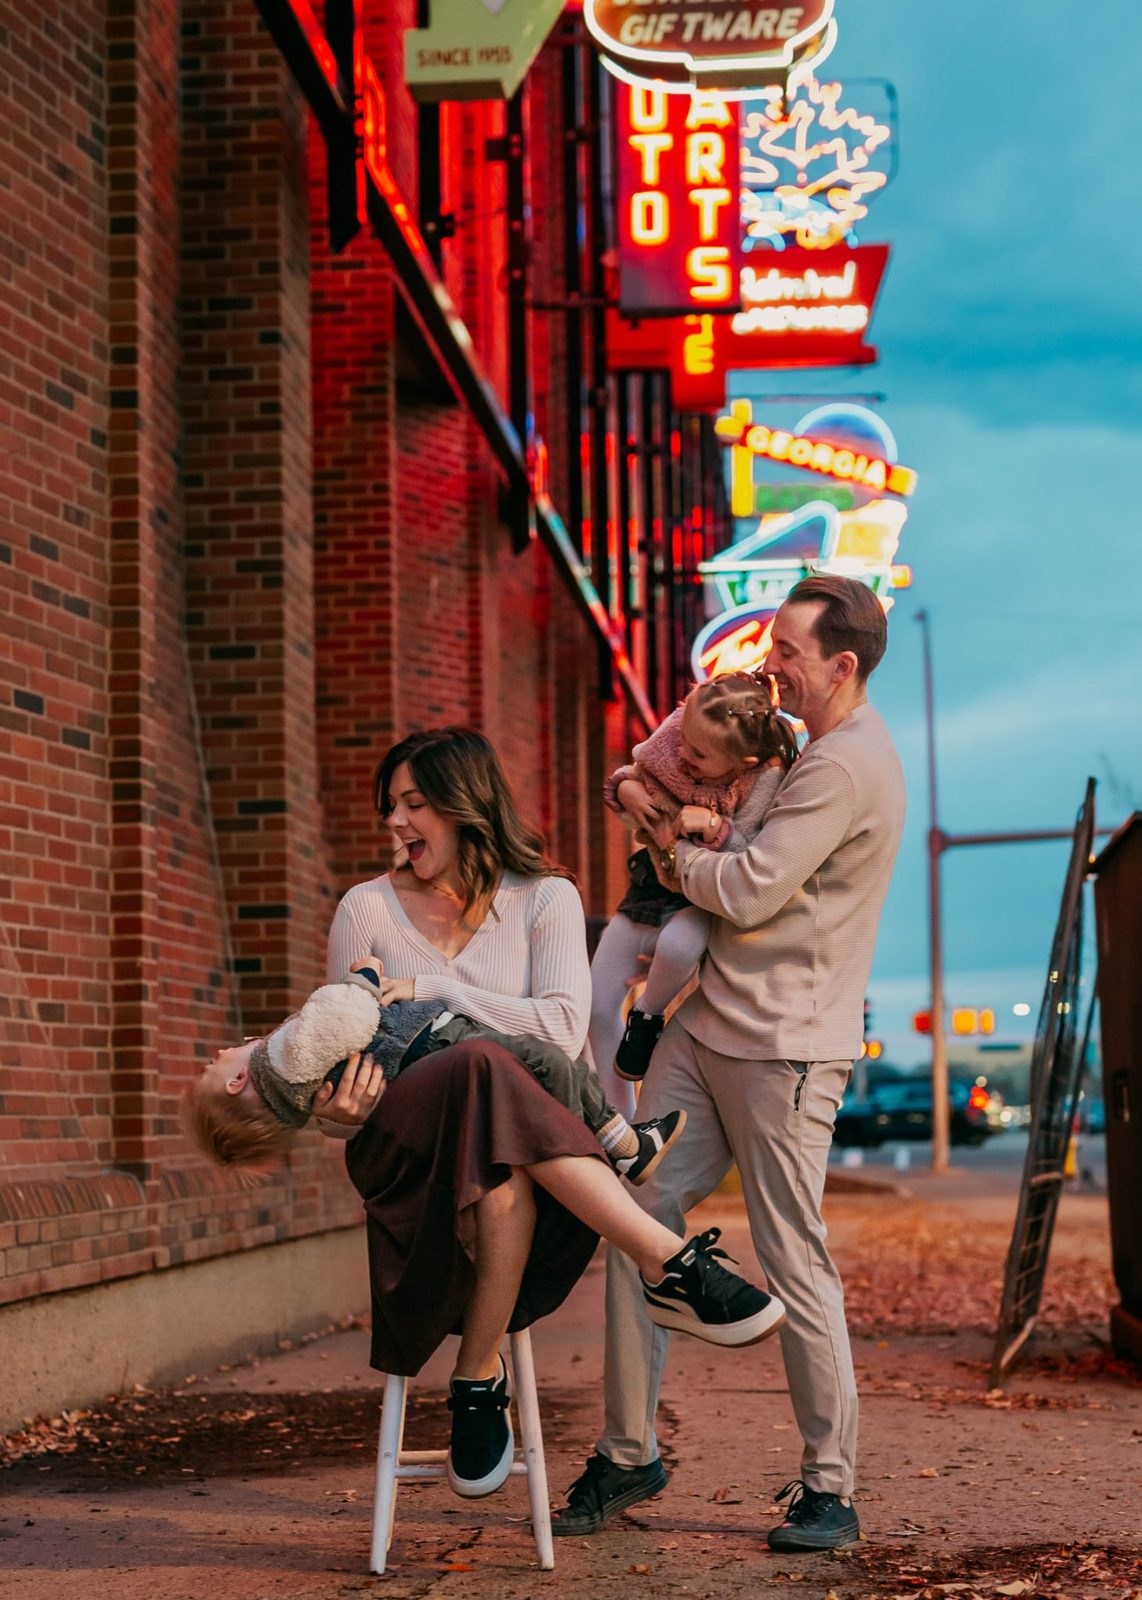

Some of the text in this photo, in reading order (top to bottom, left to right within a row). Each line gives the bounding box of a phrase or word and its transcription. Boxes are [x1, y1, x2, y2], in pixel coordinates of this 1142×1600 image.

[417, 47, 471, 68] SINCE
[629, 81, 673, 246] UTO
[686, 88, 733, 302] ARTS
[746, 425, 887, 491] GEORGIA
